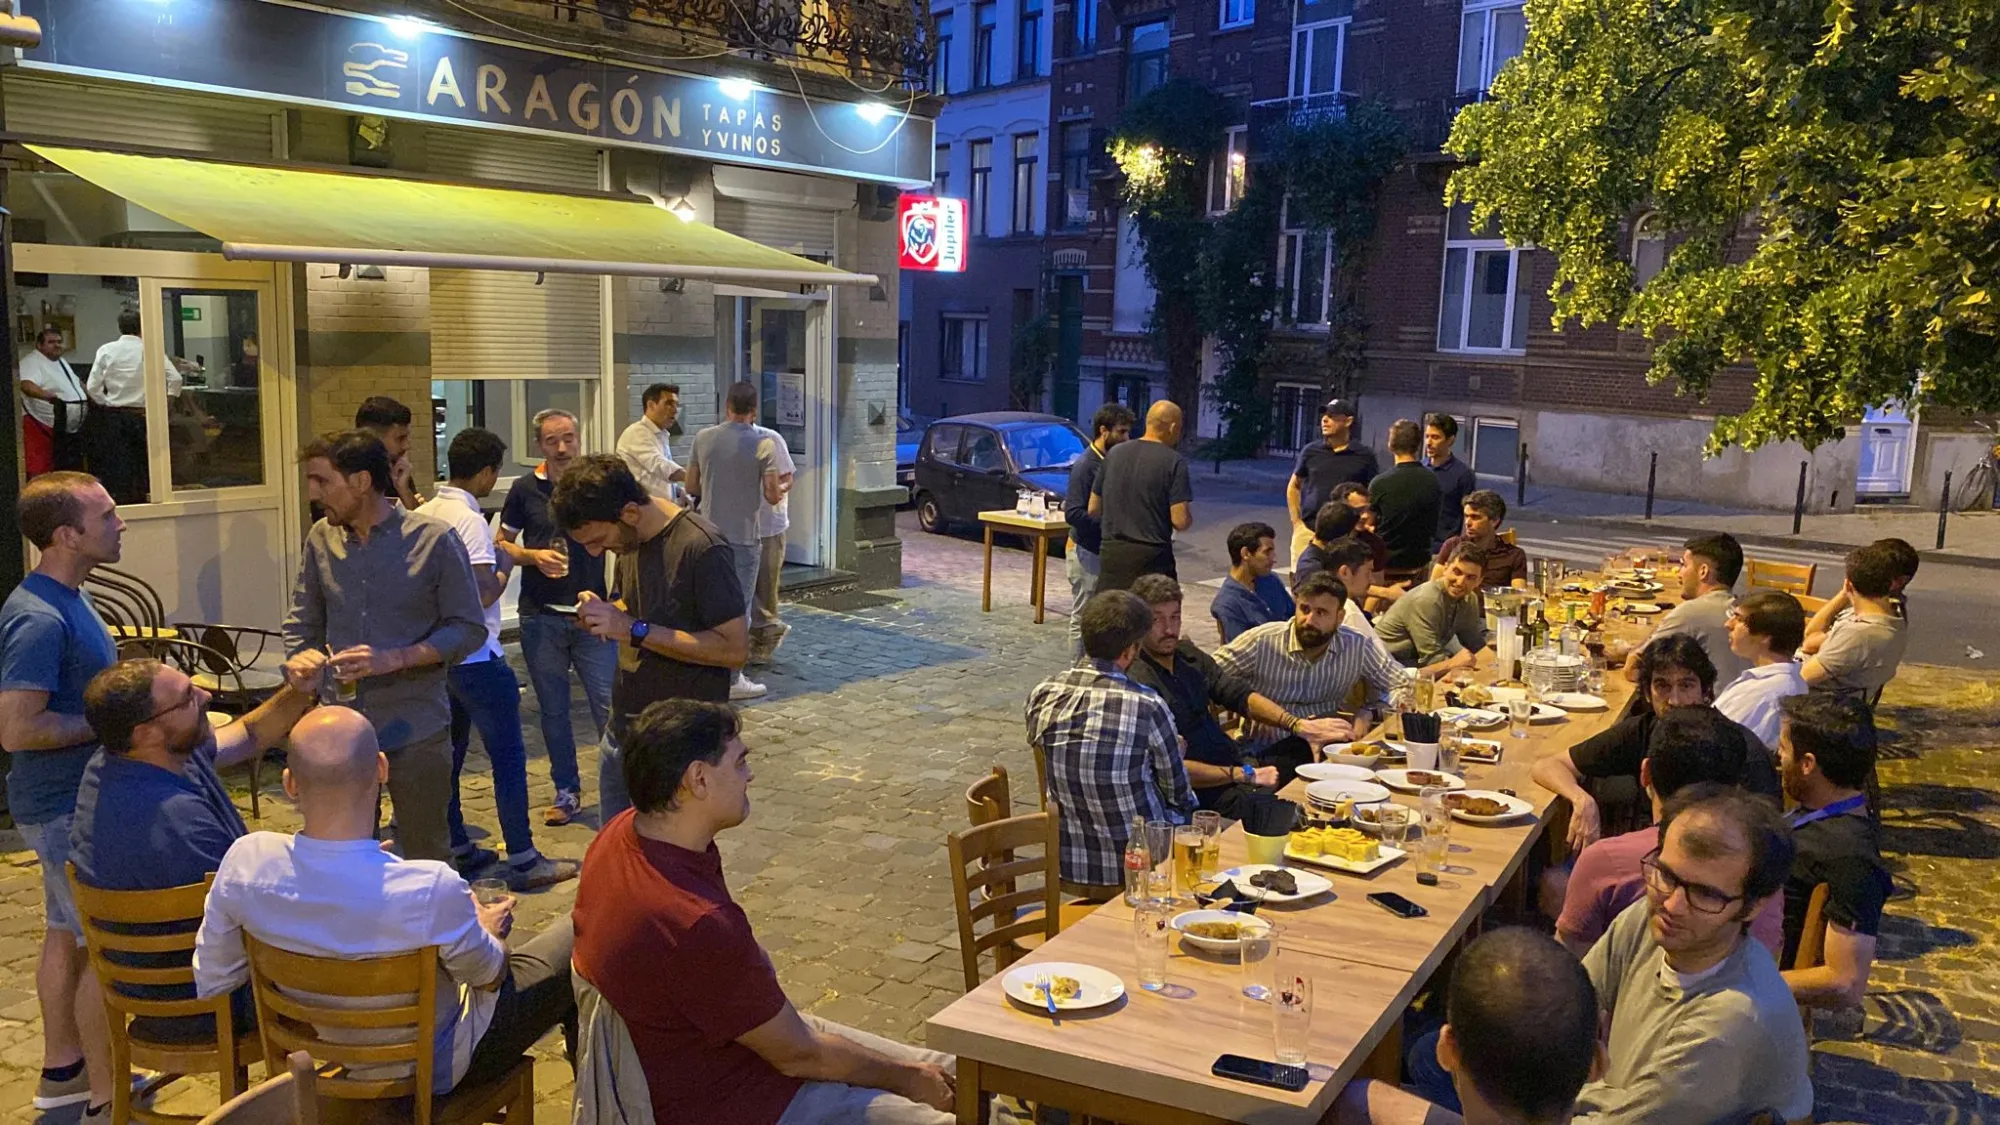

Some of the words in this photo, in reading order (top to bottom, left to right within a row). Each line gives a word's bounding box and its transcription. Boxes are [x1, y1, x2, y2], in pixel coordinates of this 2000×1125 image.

[427, 56, 681, 139] ARAGÓN
[702, 103, 782, 132] TAPAS
[943, 204, 957, 264] Jupiler
